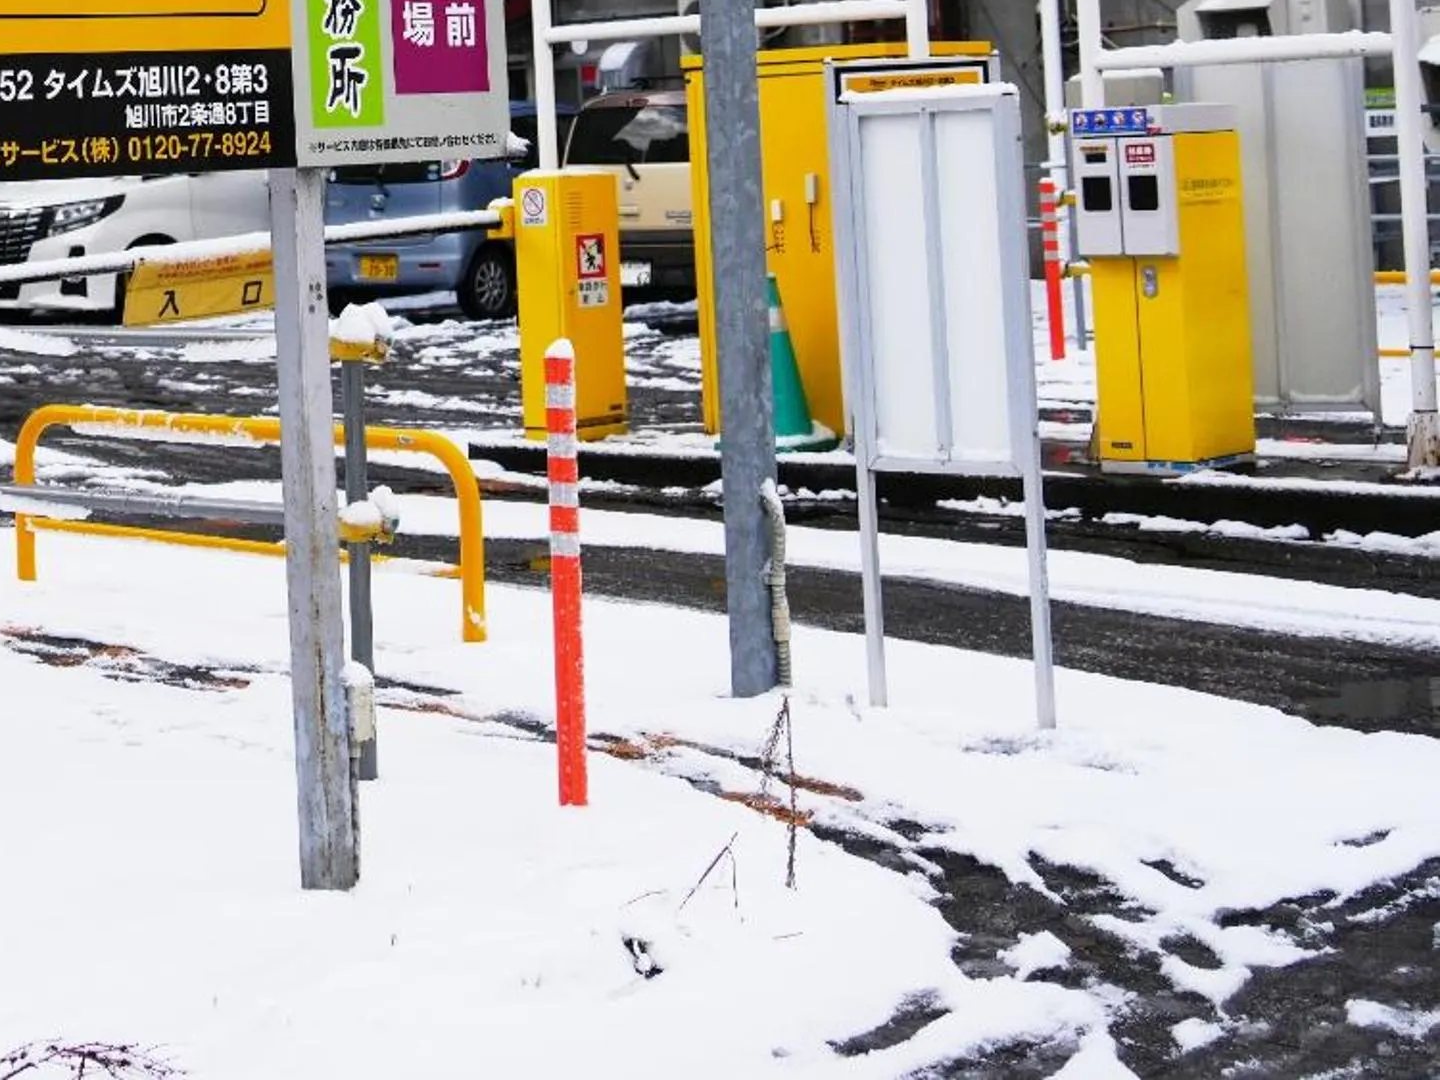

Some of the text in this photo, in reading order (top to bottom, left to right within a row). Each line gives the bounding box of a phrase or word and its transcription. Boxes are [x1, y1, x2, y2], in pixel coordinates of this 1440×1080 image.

[125, 100, 270, 129] 旭川市2条通8丁目
[127, 130, 271, 162] 0120-77-8924
